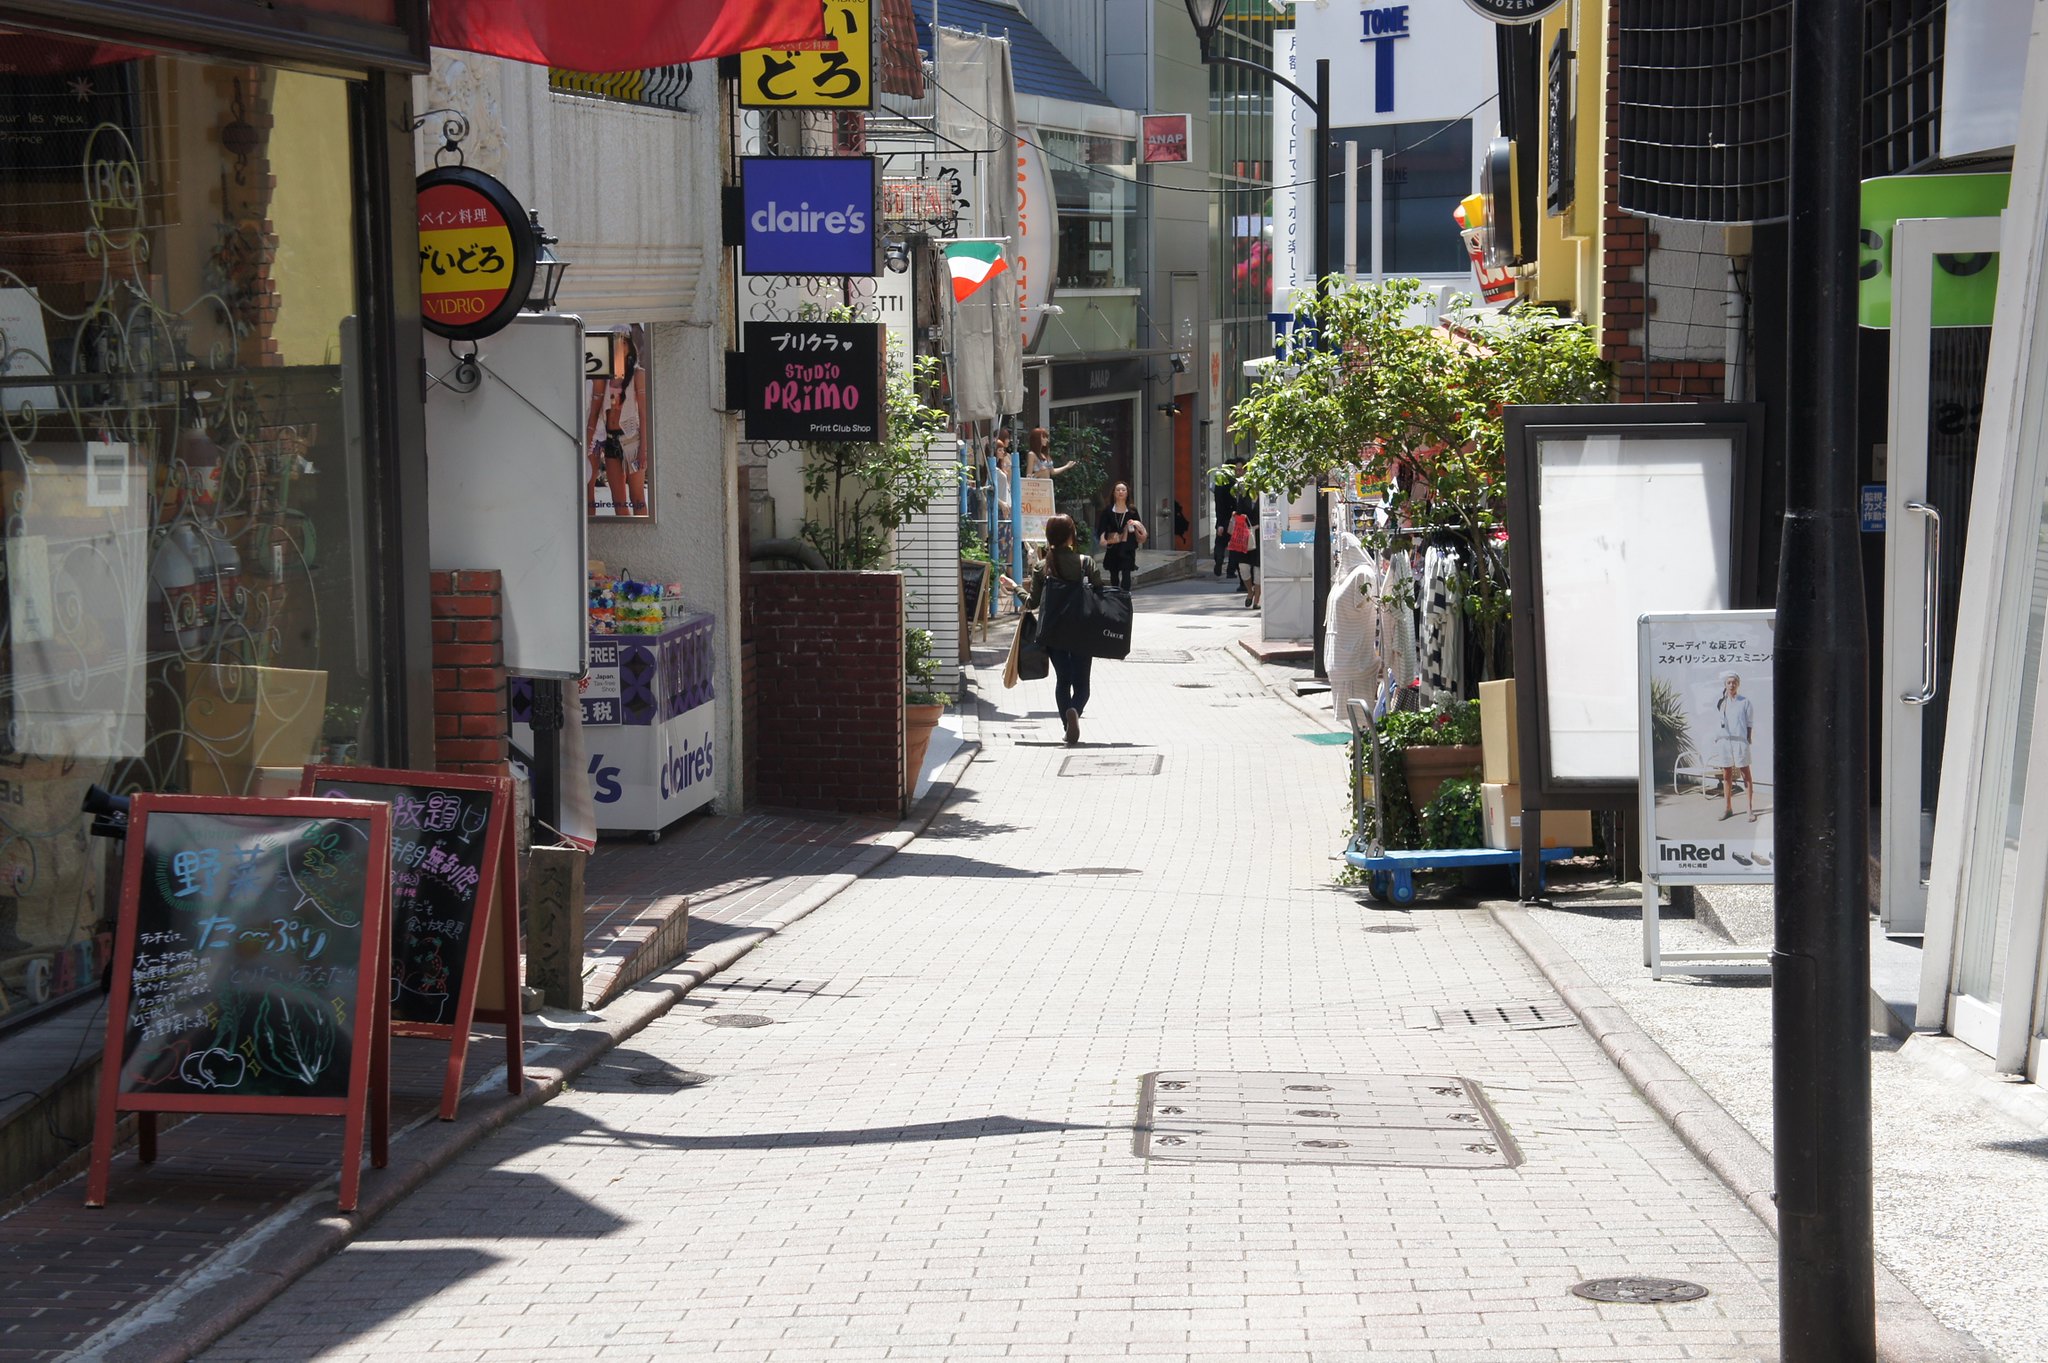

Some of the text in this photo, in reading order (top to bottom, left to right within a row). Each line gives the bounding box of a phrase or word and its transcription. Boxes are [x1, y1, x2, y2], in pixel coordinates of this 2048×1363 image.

[1360, 6, 1409, 36] TONE
[1148, 133, 1184, 145] ANAP
[418, 208, 488, 226] ペイン料理
[751, 201, 866, 234] claire's
[426, 297, 486, 315] VIDRIO
[770, 332, 837, 352] プリクラ
[1089, 369, 1111, 390] ANAP
[810, 423, 872, 433] Print Club Shop
[660, 731, 713, 800] claire's
[1660, 843, 1725, 861] InRed
